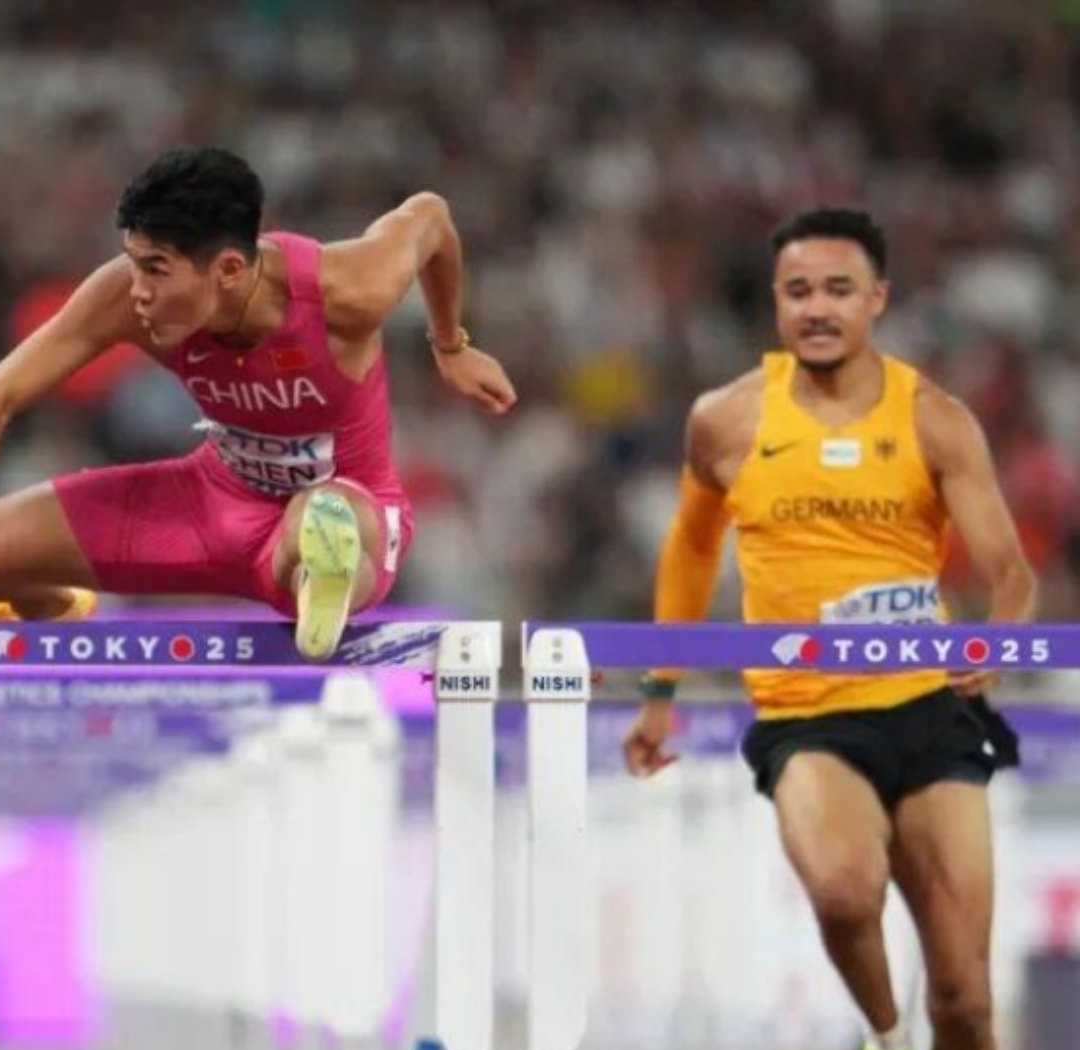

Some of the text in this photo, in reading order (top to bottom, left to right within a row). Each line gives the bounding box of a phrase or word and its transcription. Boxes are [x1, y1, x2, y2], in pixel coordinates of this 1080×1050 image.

[186, 376, 326, 412] CHINA
[770, 497, 904, 522] GERMANY
[440, 675, 491, 691] NISHI
[532, 675, 583, 692] NISHI
